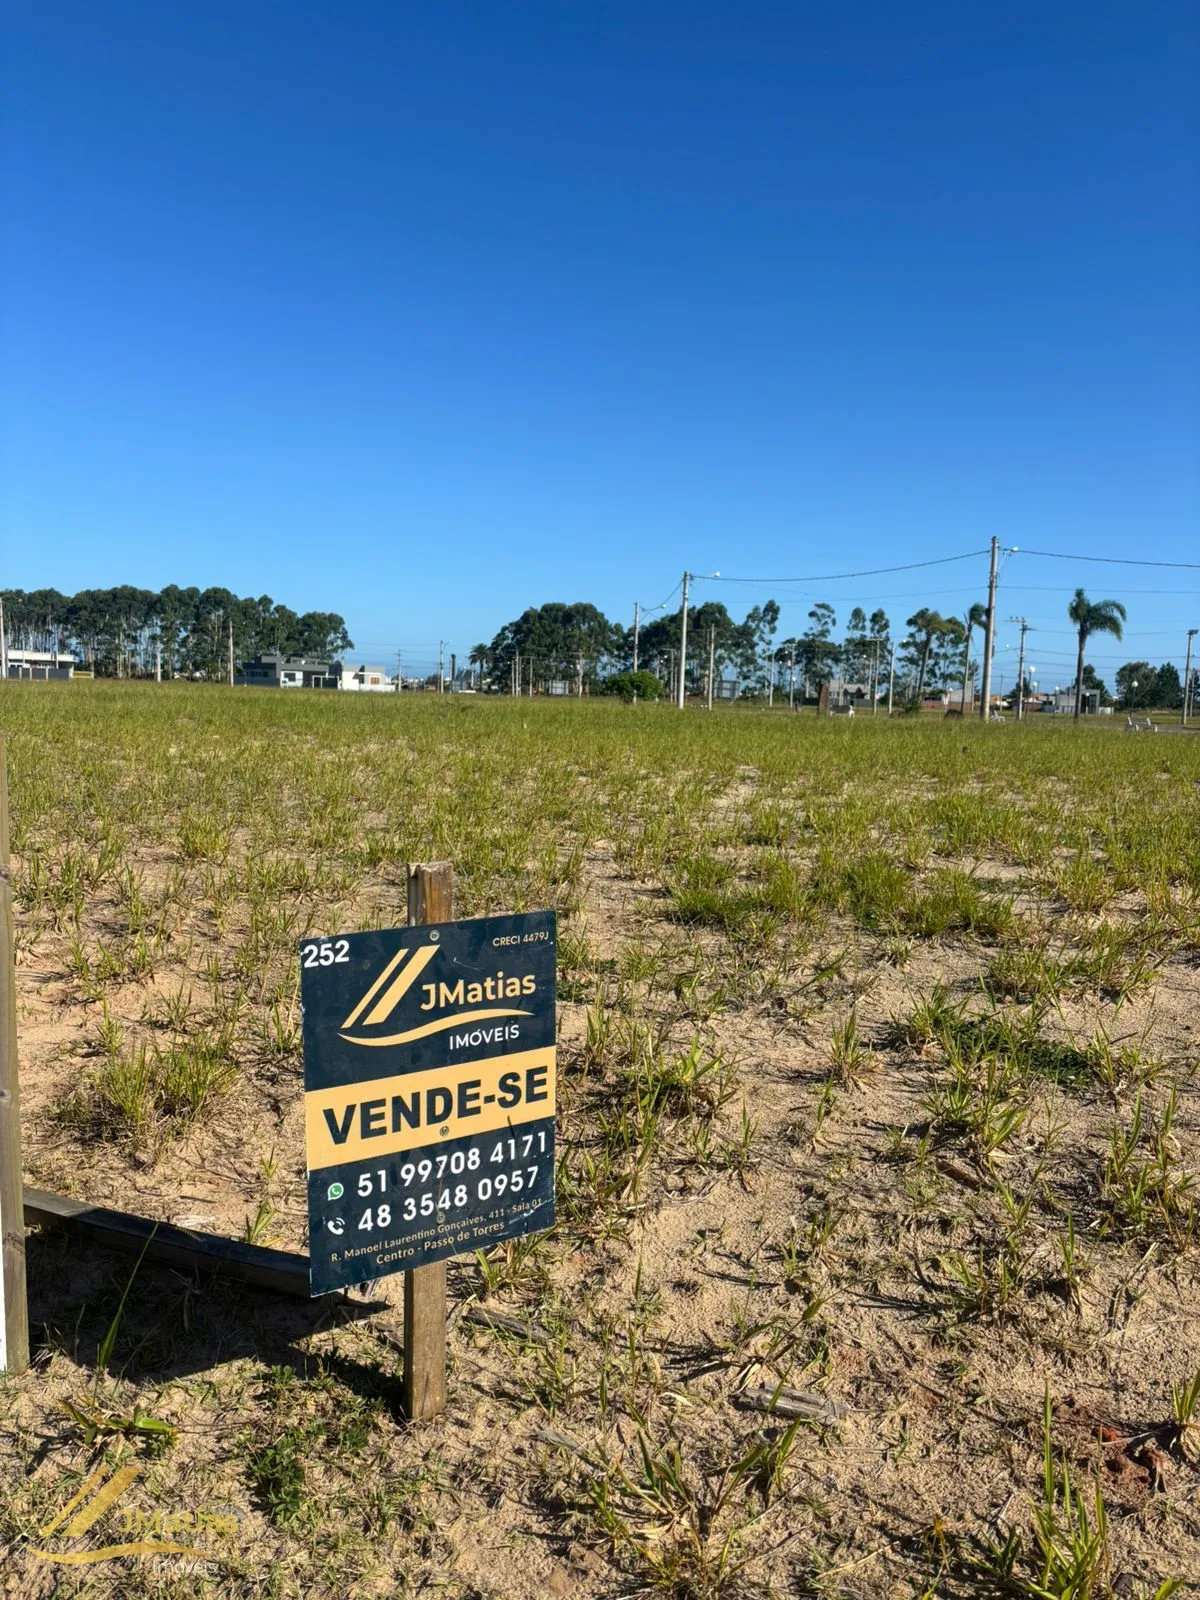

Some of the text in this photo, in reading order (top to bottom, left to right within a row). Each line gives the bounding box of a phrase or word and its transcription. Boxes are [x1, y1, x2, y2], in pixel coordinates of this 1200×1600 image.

[303, 940, 350, 968] 252
[493, 931, 550, 947] CRECI 4479J
[420, 971, 537, 1011] JMatias
[449, 1024, 520, 1050] IMÓVEIS
[322, 1065, 548, 1145] VENDE-SE
[357, 1131, 546, 1197] 51 99708 4171
[358, 1165, 539, 1232] 48 3548 0957
[331, 1253, 342, 1262] R.
[344, 1242, 383, 1259] Manoel
[384, 1228, 436, 1249] Laurentino
[437, 1214, 487, 1236] Gonçalves,
[488, 1208, 505, 1219] 411
[511, 1201, 531, 1214] Sala
[531, 1197, 543, 1208] 01
[376, 1247, 415, 1265] Centro
[424, 1238, 455, 1251] Passo
[457, 1231, 470, 1242] de
[472, 1221, 505, 1235] Torres
